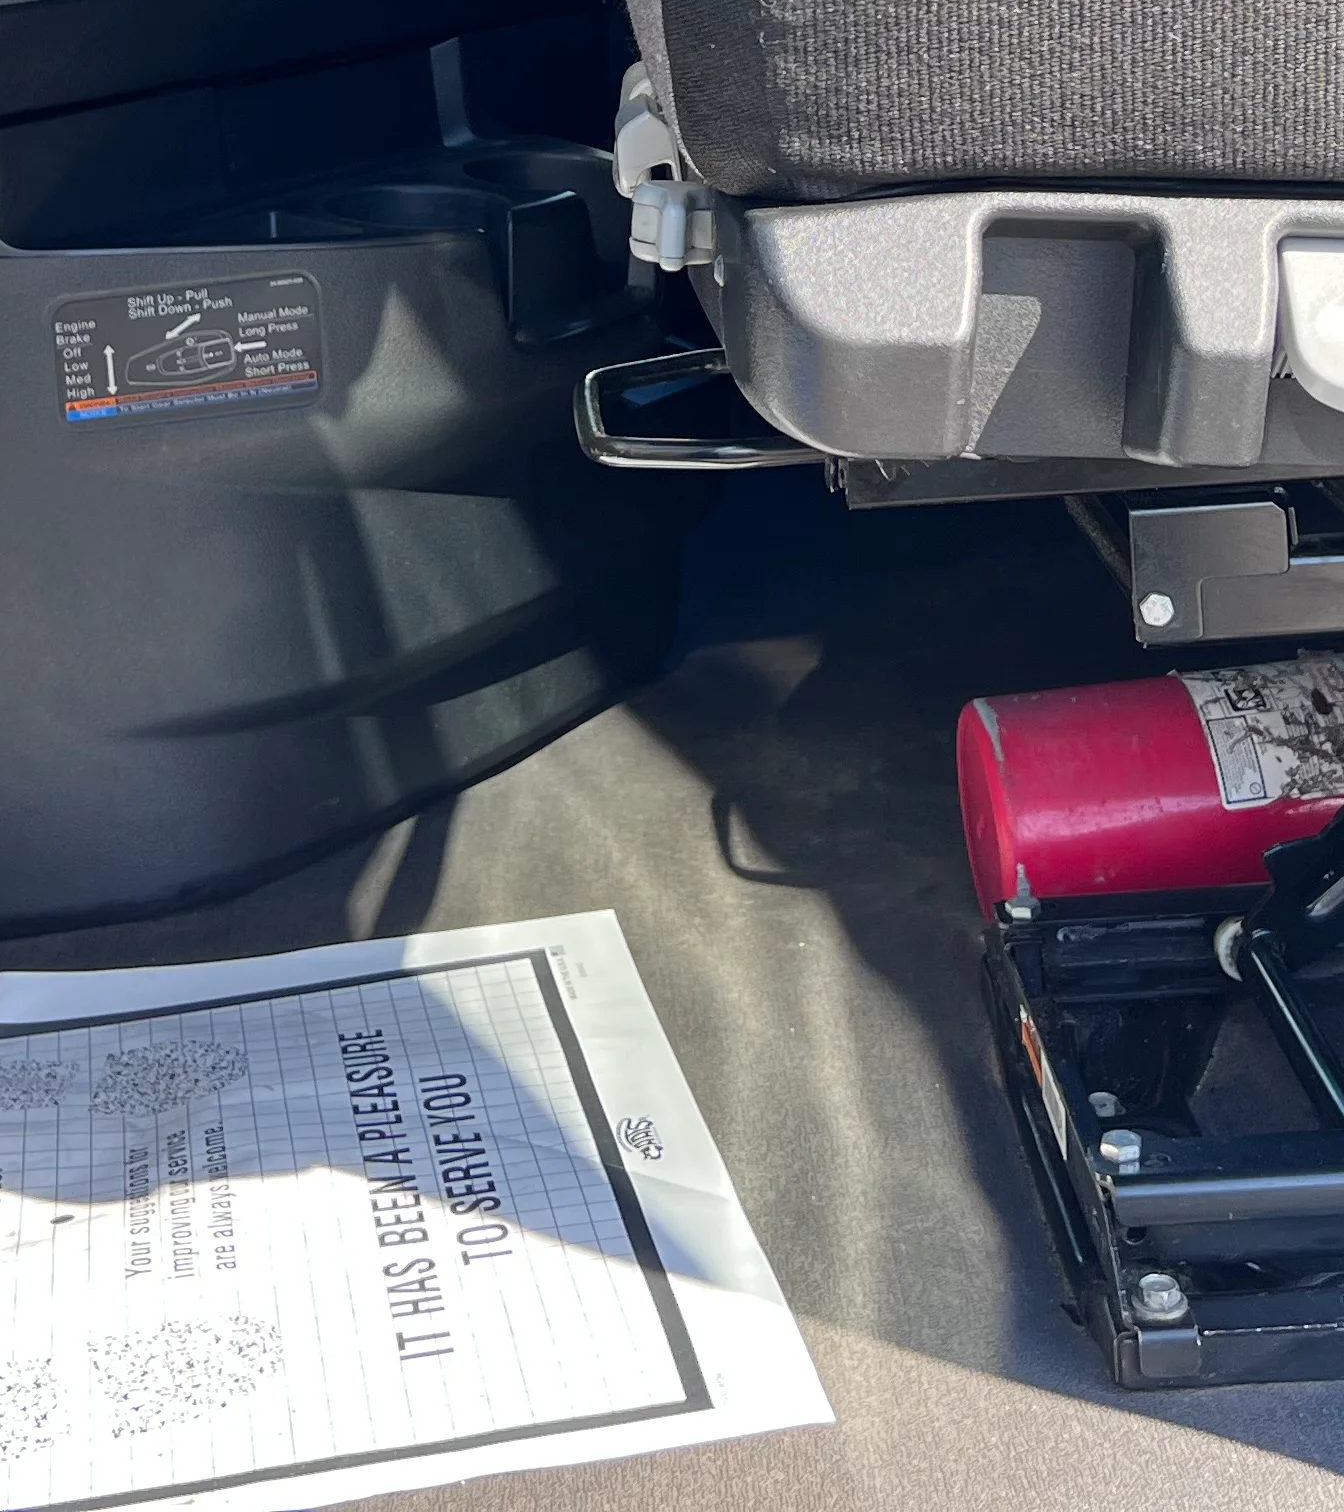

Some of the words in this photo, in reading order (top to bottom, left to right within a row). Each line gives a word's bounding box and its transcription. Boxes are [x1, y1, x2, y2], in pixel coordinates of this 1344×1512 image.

[127, 294, 155, 309] Shift
[157, 293, 175, 305] Up
[185, 288, 209, 301] Pull
[128, 306, 156, 320] Shift
[158, 304, 192, 316] Down
[202, 296, 233, 310] Push
[237, 309, 277, 323] Manual
[278, 305, 309, 318] Mode
[55, 320, 96, 334] Engine
[238, 325, 266, 338] Long
[268, 321, 300, 334] Press
[56, 333, 91, 346] Brake
[63, 347, 82, 360] Off
[243, 352, 270, 364] Auto
[272, 348, 304, 360] Mode
[63, 361, 89, 373] Low
[244, 364, 276, 378] Short
[277, 361, 310, 373] Press
[65, 373, 92, 386] Med
[66, 386, 96, 400] High
[338, 1029, 407, 1142] PLEASURE
[419, 1073, 476, 1128] YOU
[124, 1146, 149, 1164] for
[162, 1130, 188, 1176] service
[363, 1147, 413, 1165] A
[433, 1132, 501, 1216] SERVE
[207, 1184, 237, 1238] always
[367, 1174, 430, 1248] BEEN
[164, 1197, 200, 1280] improving
[457, 1223, 513, 1266] TO
[125, 1241, 152, 1280] Your
[215, 1245, 237, 1270] are
[382, 1257, 445, 1318] HAS
[396, 1331, 454, 1361] IT
